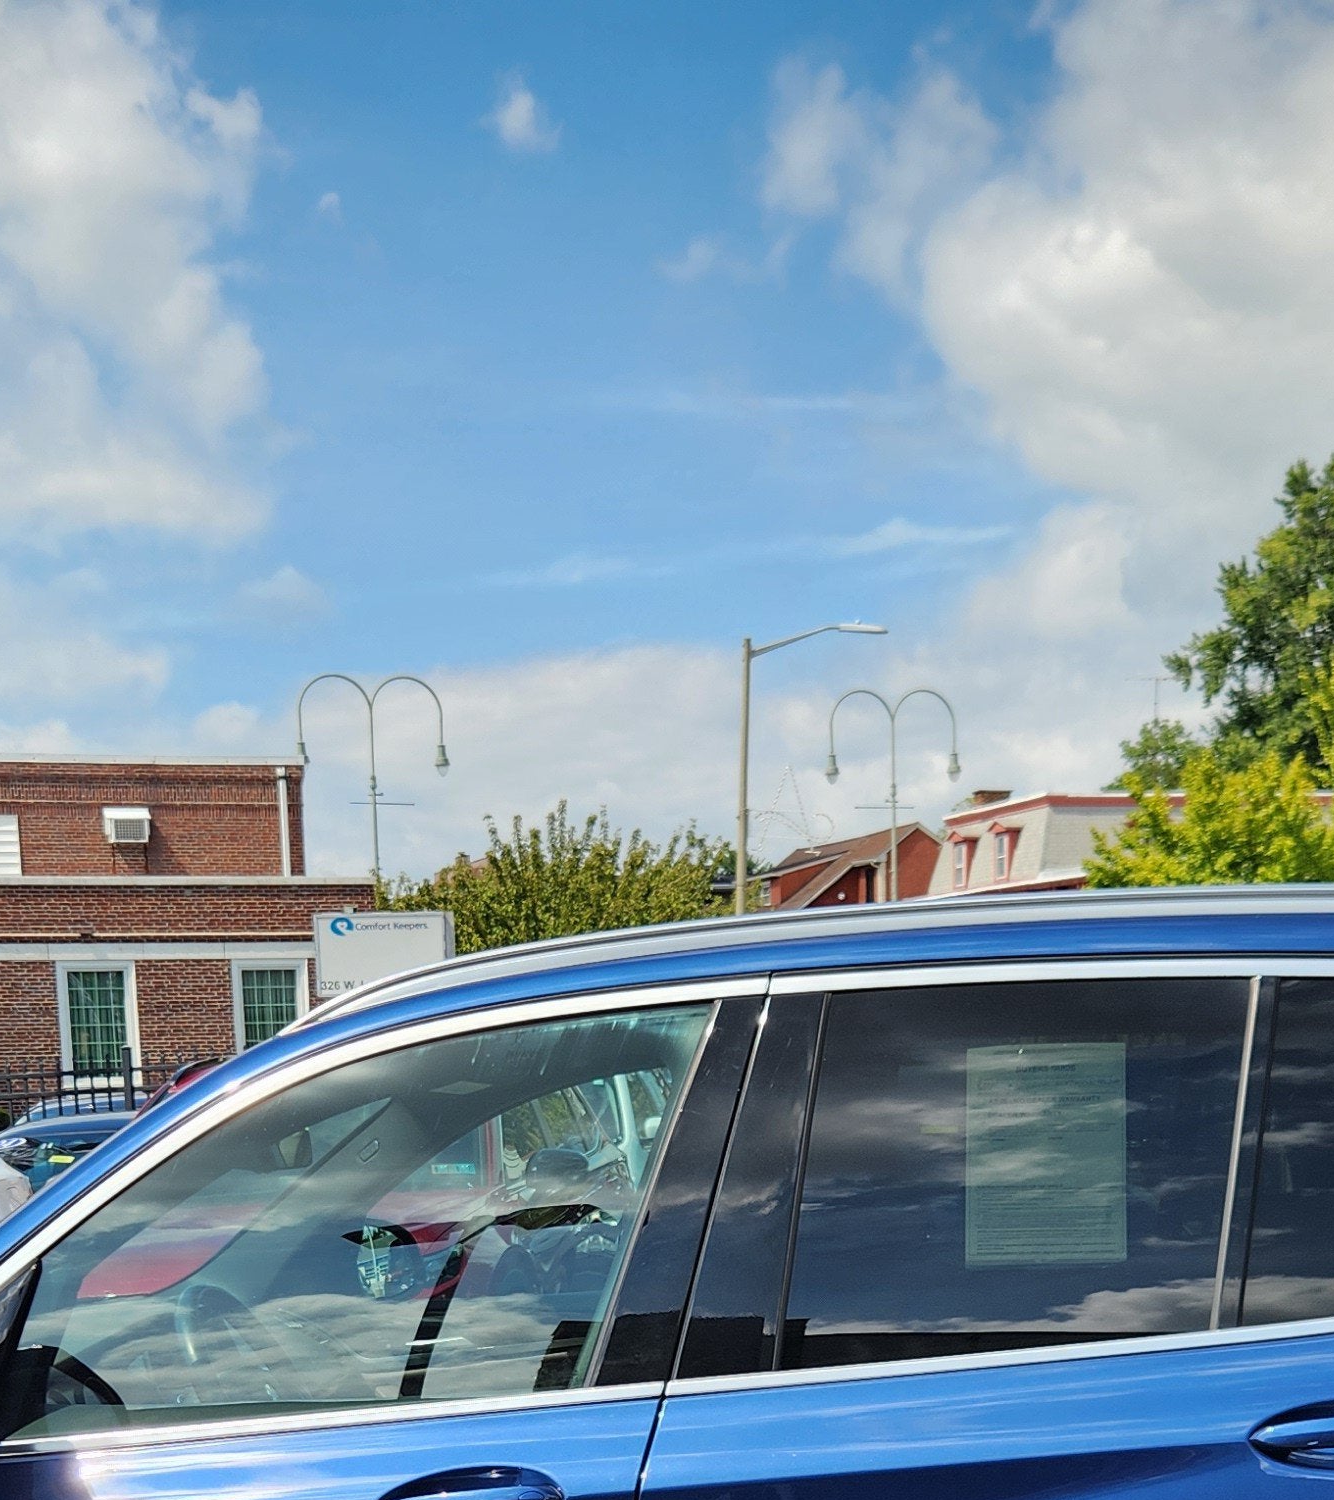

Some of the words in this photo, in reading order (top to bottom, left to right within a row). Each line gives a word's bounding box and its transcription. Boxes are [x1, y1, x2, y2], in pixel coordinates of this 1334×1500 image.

[355, 921, 391, 931] Comfort
[321, 980, 340, 991] 326
[344, 980, 356, 990] W
